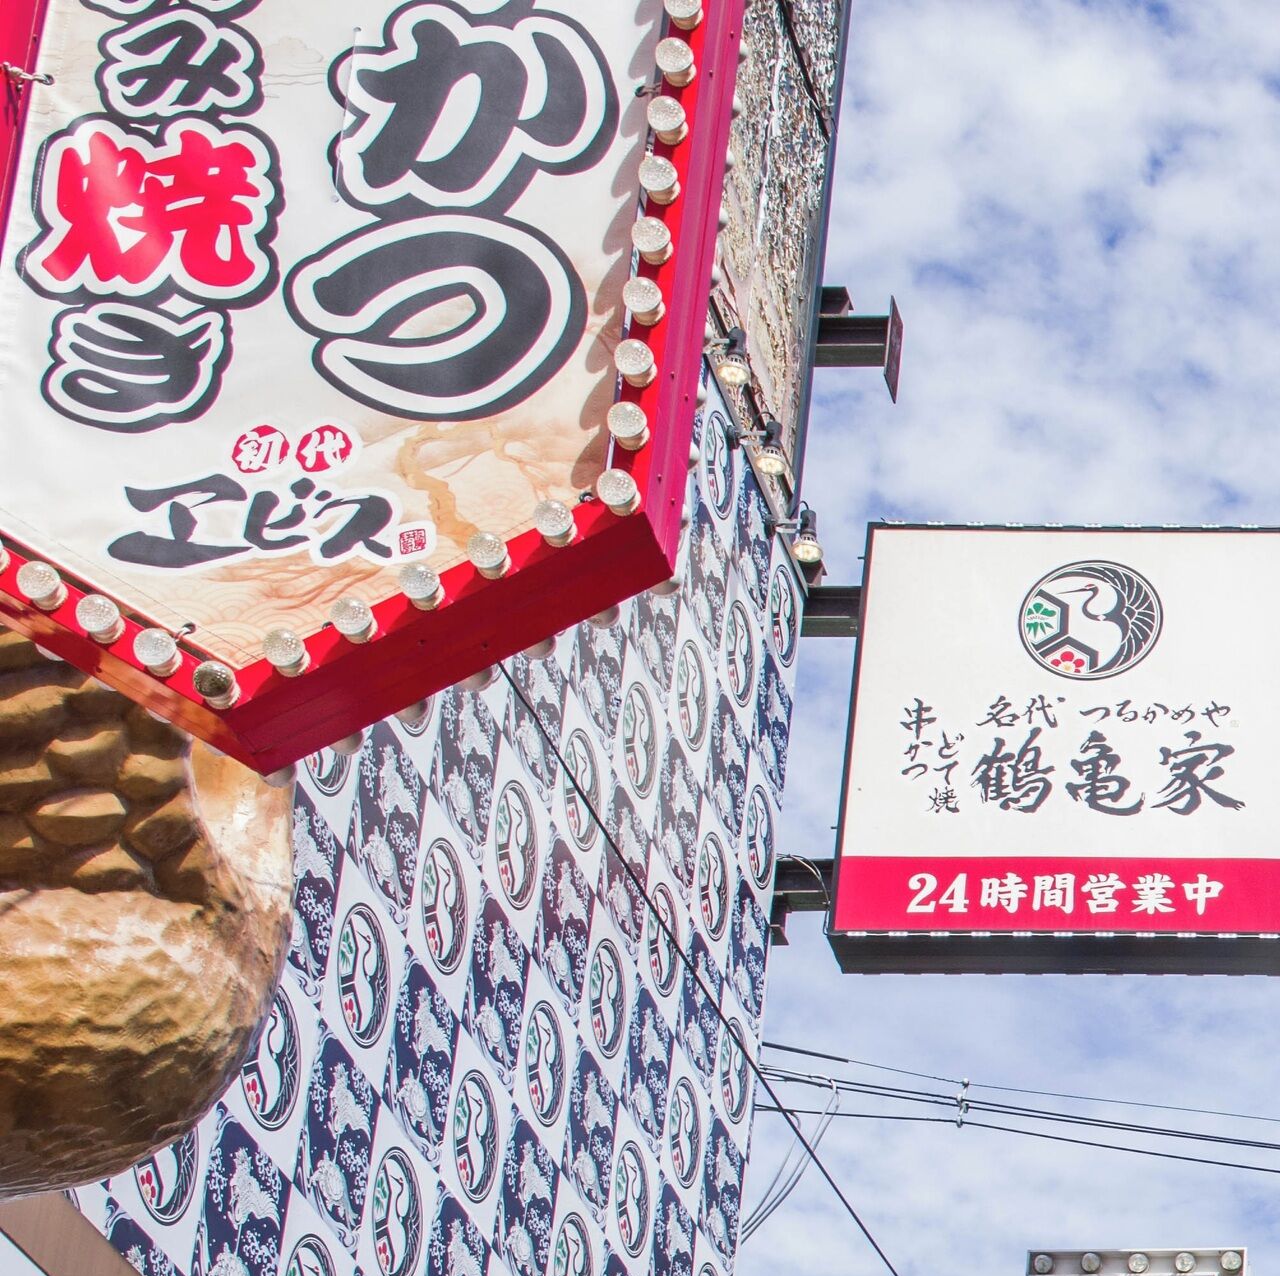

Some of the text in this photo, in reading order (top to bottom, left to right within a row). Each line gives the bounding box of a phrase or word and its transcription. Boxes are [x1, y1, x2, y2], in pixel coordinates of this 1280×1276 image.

[308, 12, 592, 400] かつ
[232, 424, 351, 473] 初代
[899, 697, 938, 781] 串かつ
[923, 730, 966, 815] どて焼
[970, 726, 1247, 817] 鶴亀家
[906, 872, 1225, 916] 24時間営業中
